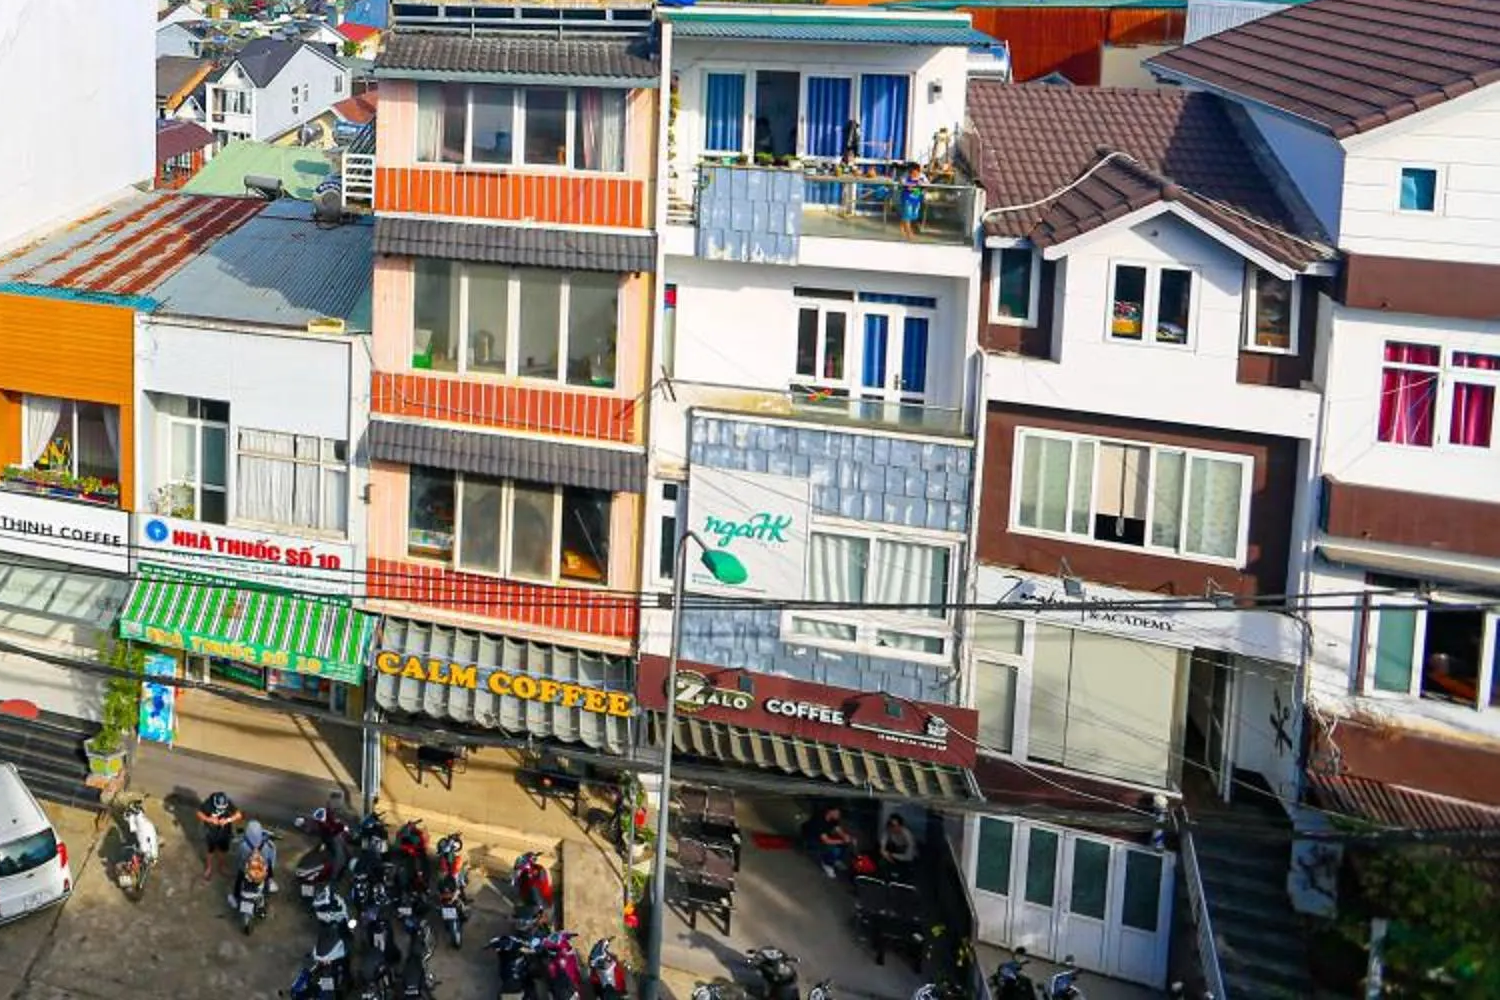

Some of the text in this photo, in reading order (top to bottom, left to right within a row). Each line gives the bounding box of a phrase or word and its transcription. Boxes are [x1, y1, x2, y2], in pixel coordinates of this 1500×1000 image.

[60, 527, 122, 547] COFFEE
[172, 529, 213, 551] NHÀ
[216, 537, 281, 561] THUỐC
[285, 545, 315, 567] SỐ
[317, 554, 341, 570] 10
[1103, 611, 1176, 632] ACADEMY
[376, 650, 478, 689] CALM
[487, 670, 634, 717] COFFEE
[766, 698, 845, 725] COFFEE
